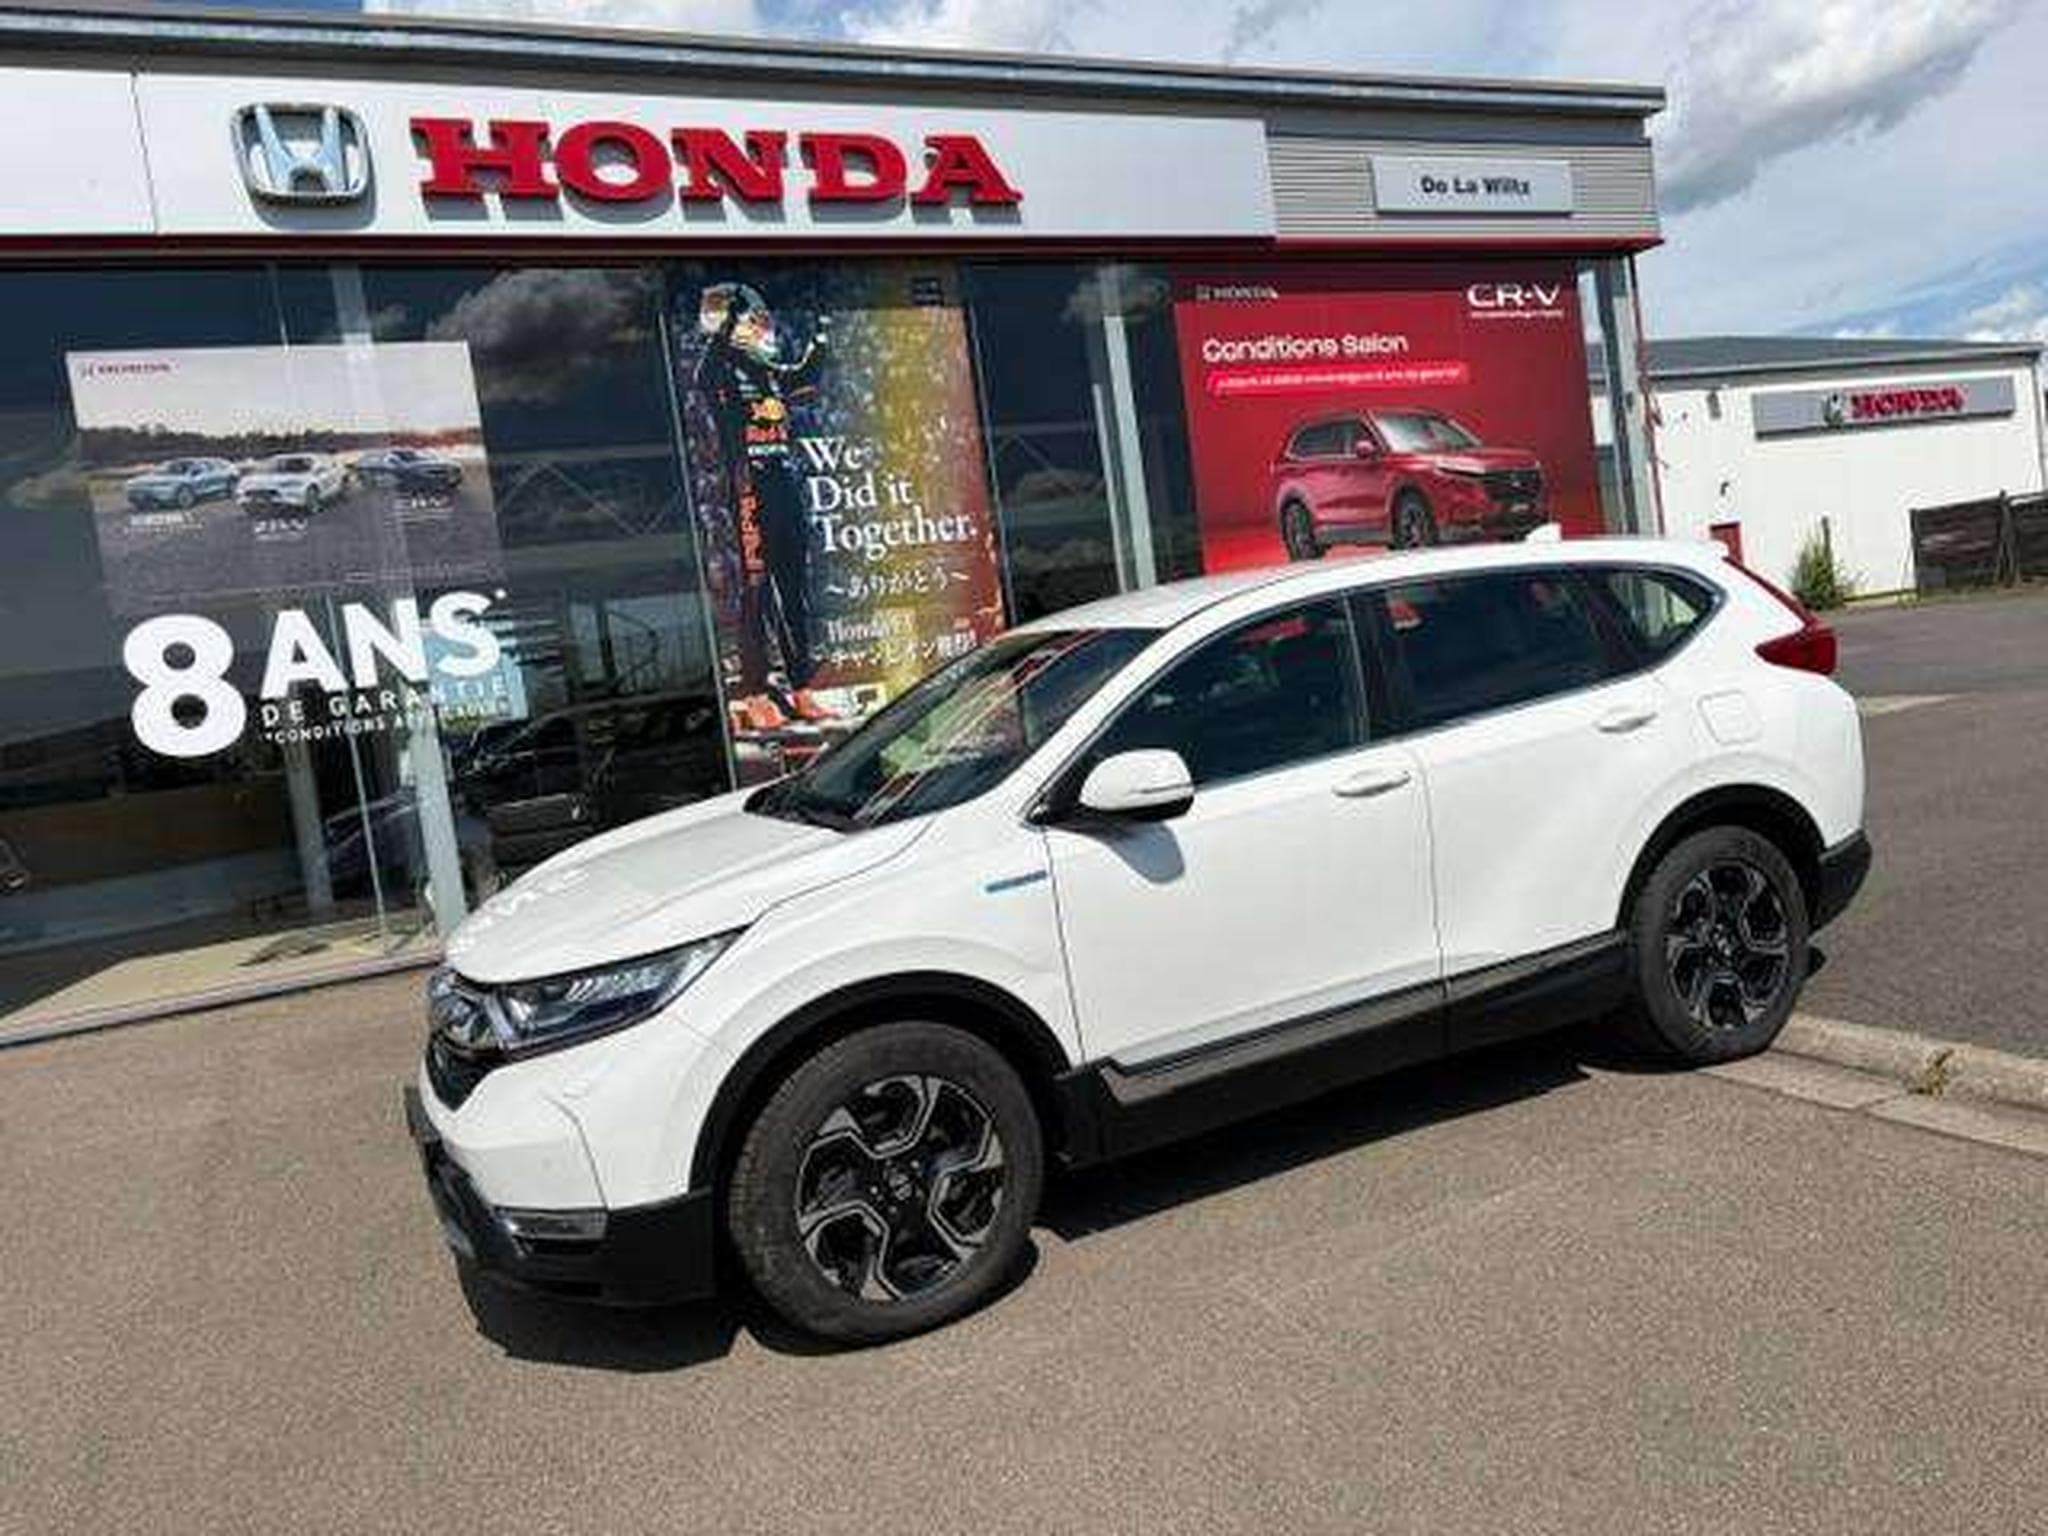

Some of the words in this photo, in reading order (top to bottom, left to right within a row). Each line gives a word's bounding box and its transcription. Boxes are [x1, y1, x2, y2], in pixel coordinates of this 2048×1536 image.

[410, 118, 1022, 205] HONDA
[1453, 177, 1478, 194] La
[1202, 336, 1338, 363] Conditions
[1341, 331, 1410, 356] Salon
[1851, 386, 1964, 419] HONDA
[799, 437, 867, 471] We
[807, 472, 877, 512] Did
[883, 472, 913, 506] it
[812, 504, 977, 561] Together.
[123, 614, 247, 758] 8
[262, 701, 304, 728] DE
